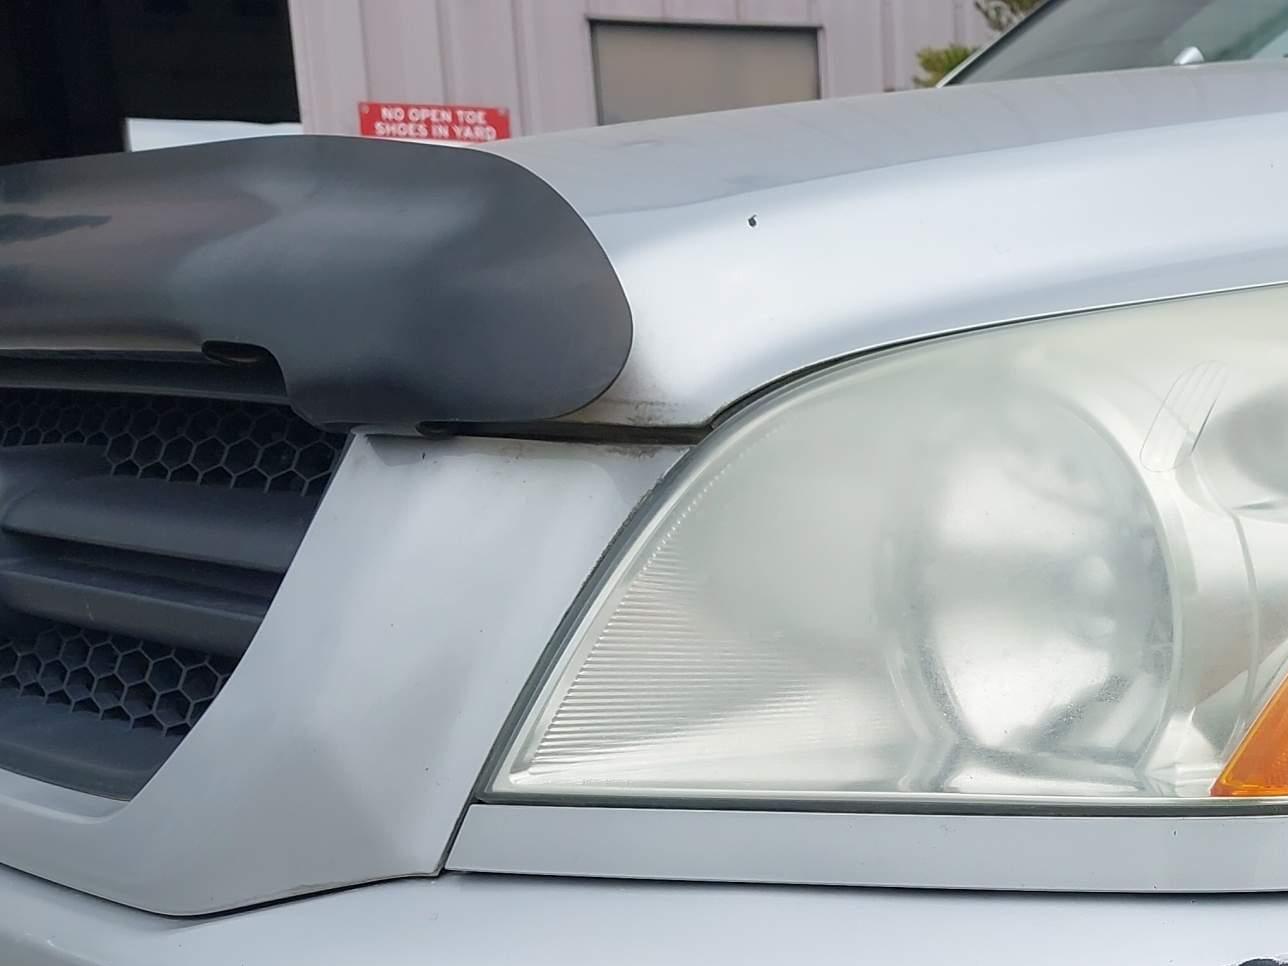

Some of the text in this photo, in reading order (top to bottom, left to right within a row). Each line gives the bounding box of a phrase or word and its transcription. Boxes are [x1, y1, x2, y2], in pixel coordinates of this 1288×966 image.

[381, 107, 487, 124] NO OPEN TOE
[374, 122, 497, 142] SHOES IN YARD
